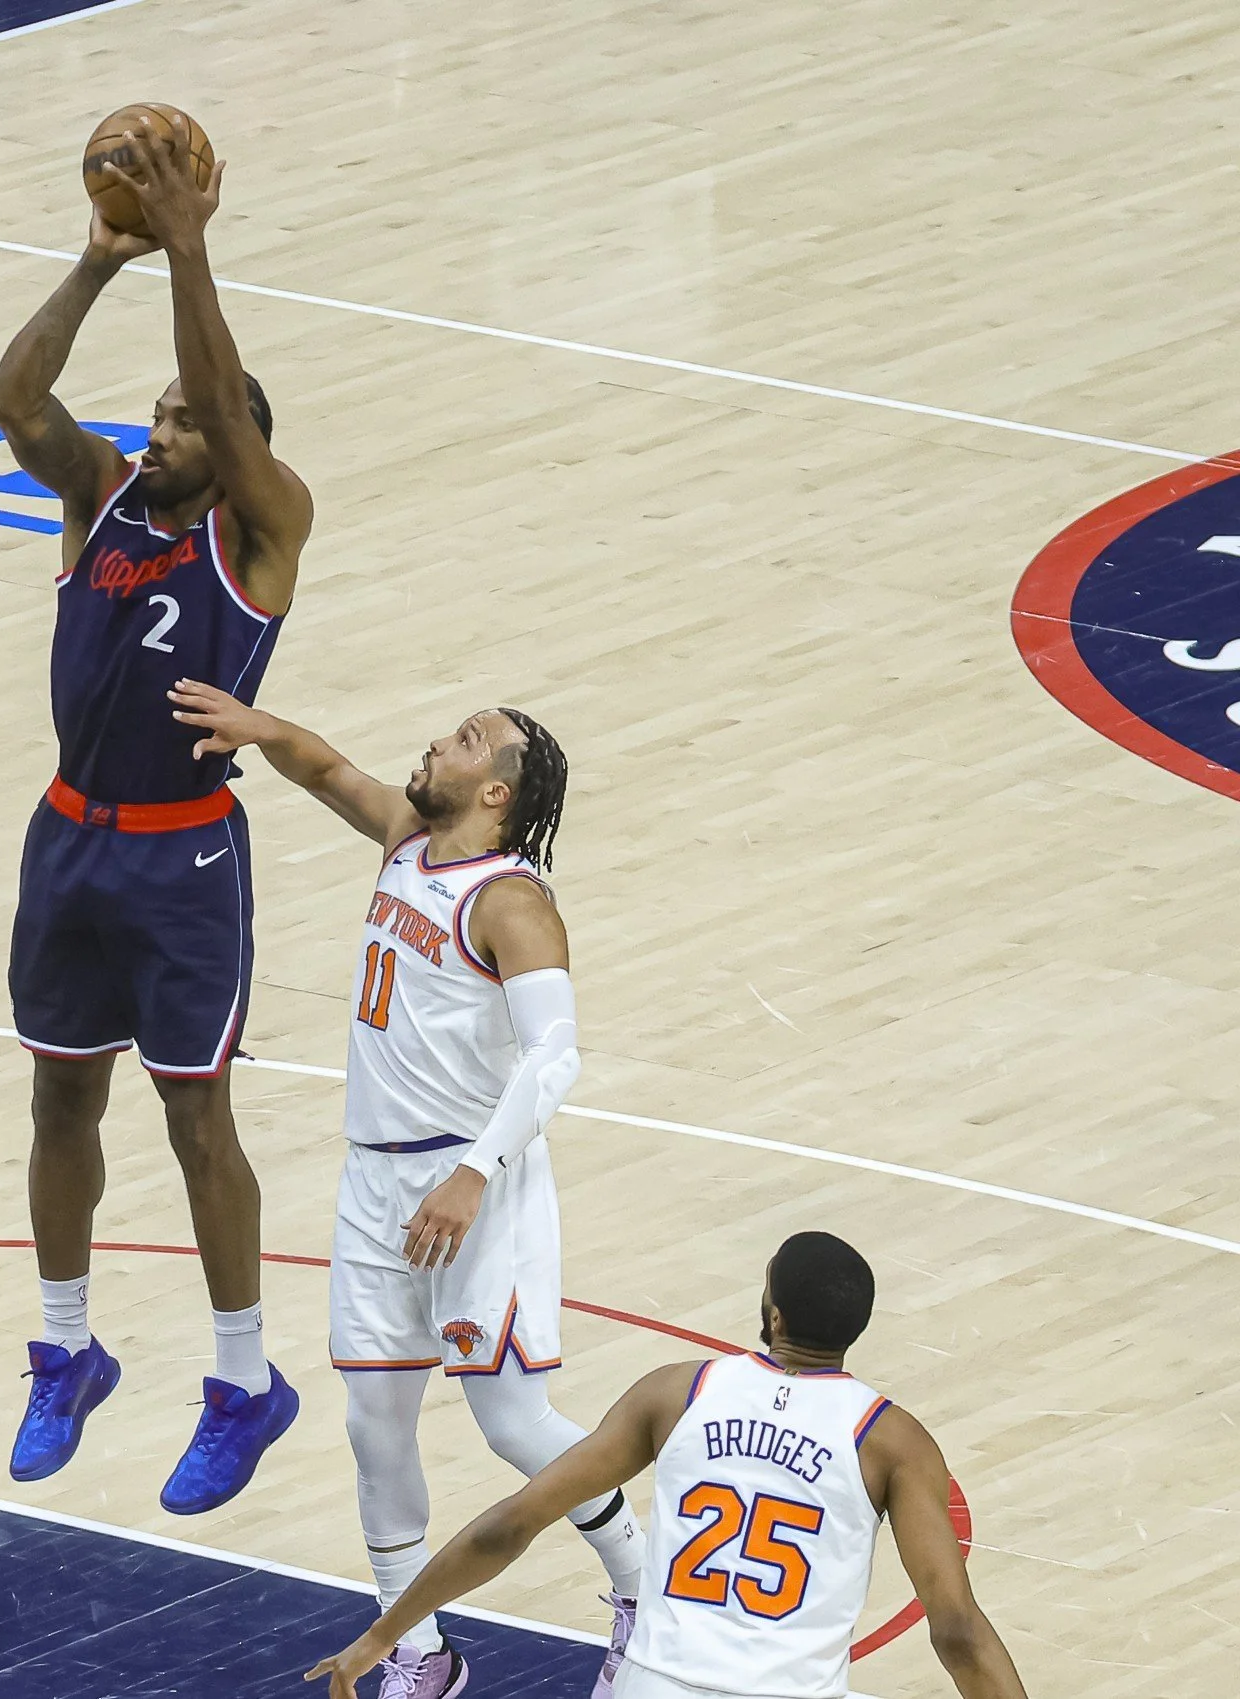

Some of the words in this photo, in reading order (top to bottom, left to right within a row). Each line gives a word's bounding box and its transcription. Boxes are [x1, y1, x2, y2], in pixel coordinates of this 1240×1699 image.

[141, 594, 181, 653] 2
[389, 899, 450, 969] YORK
[357, 940, 396, 1032] 11
[703, 1418, 833, 1484] BRIDGES
[663, 1480, 825, 1622] 25
